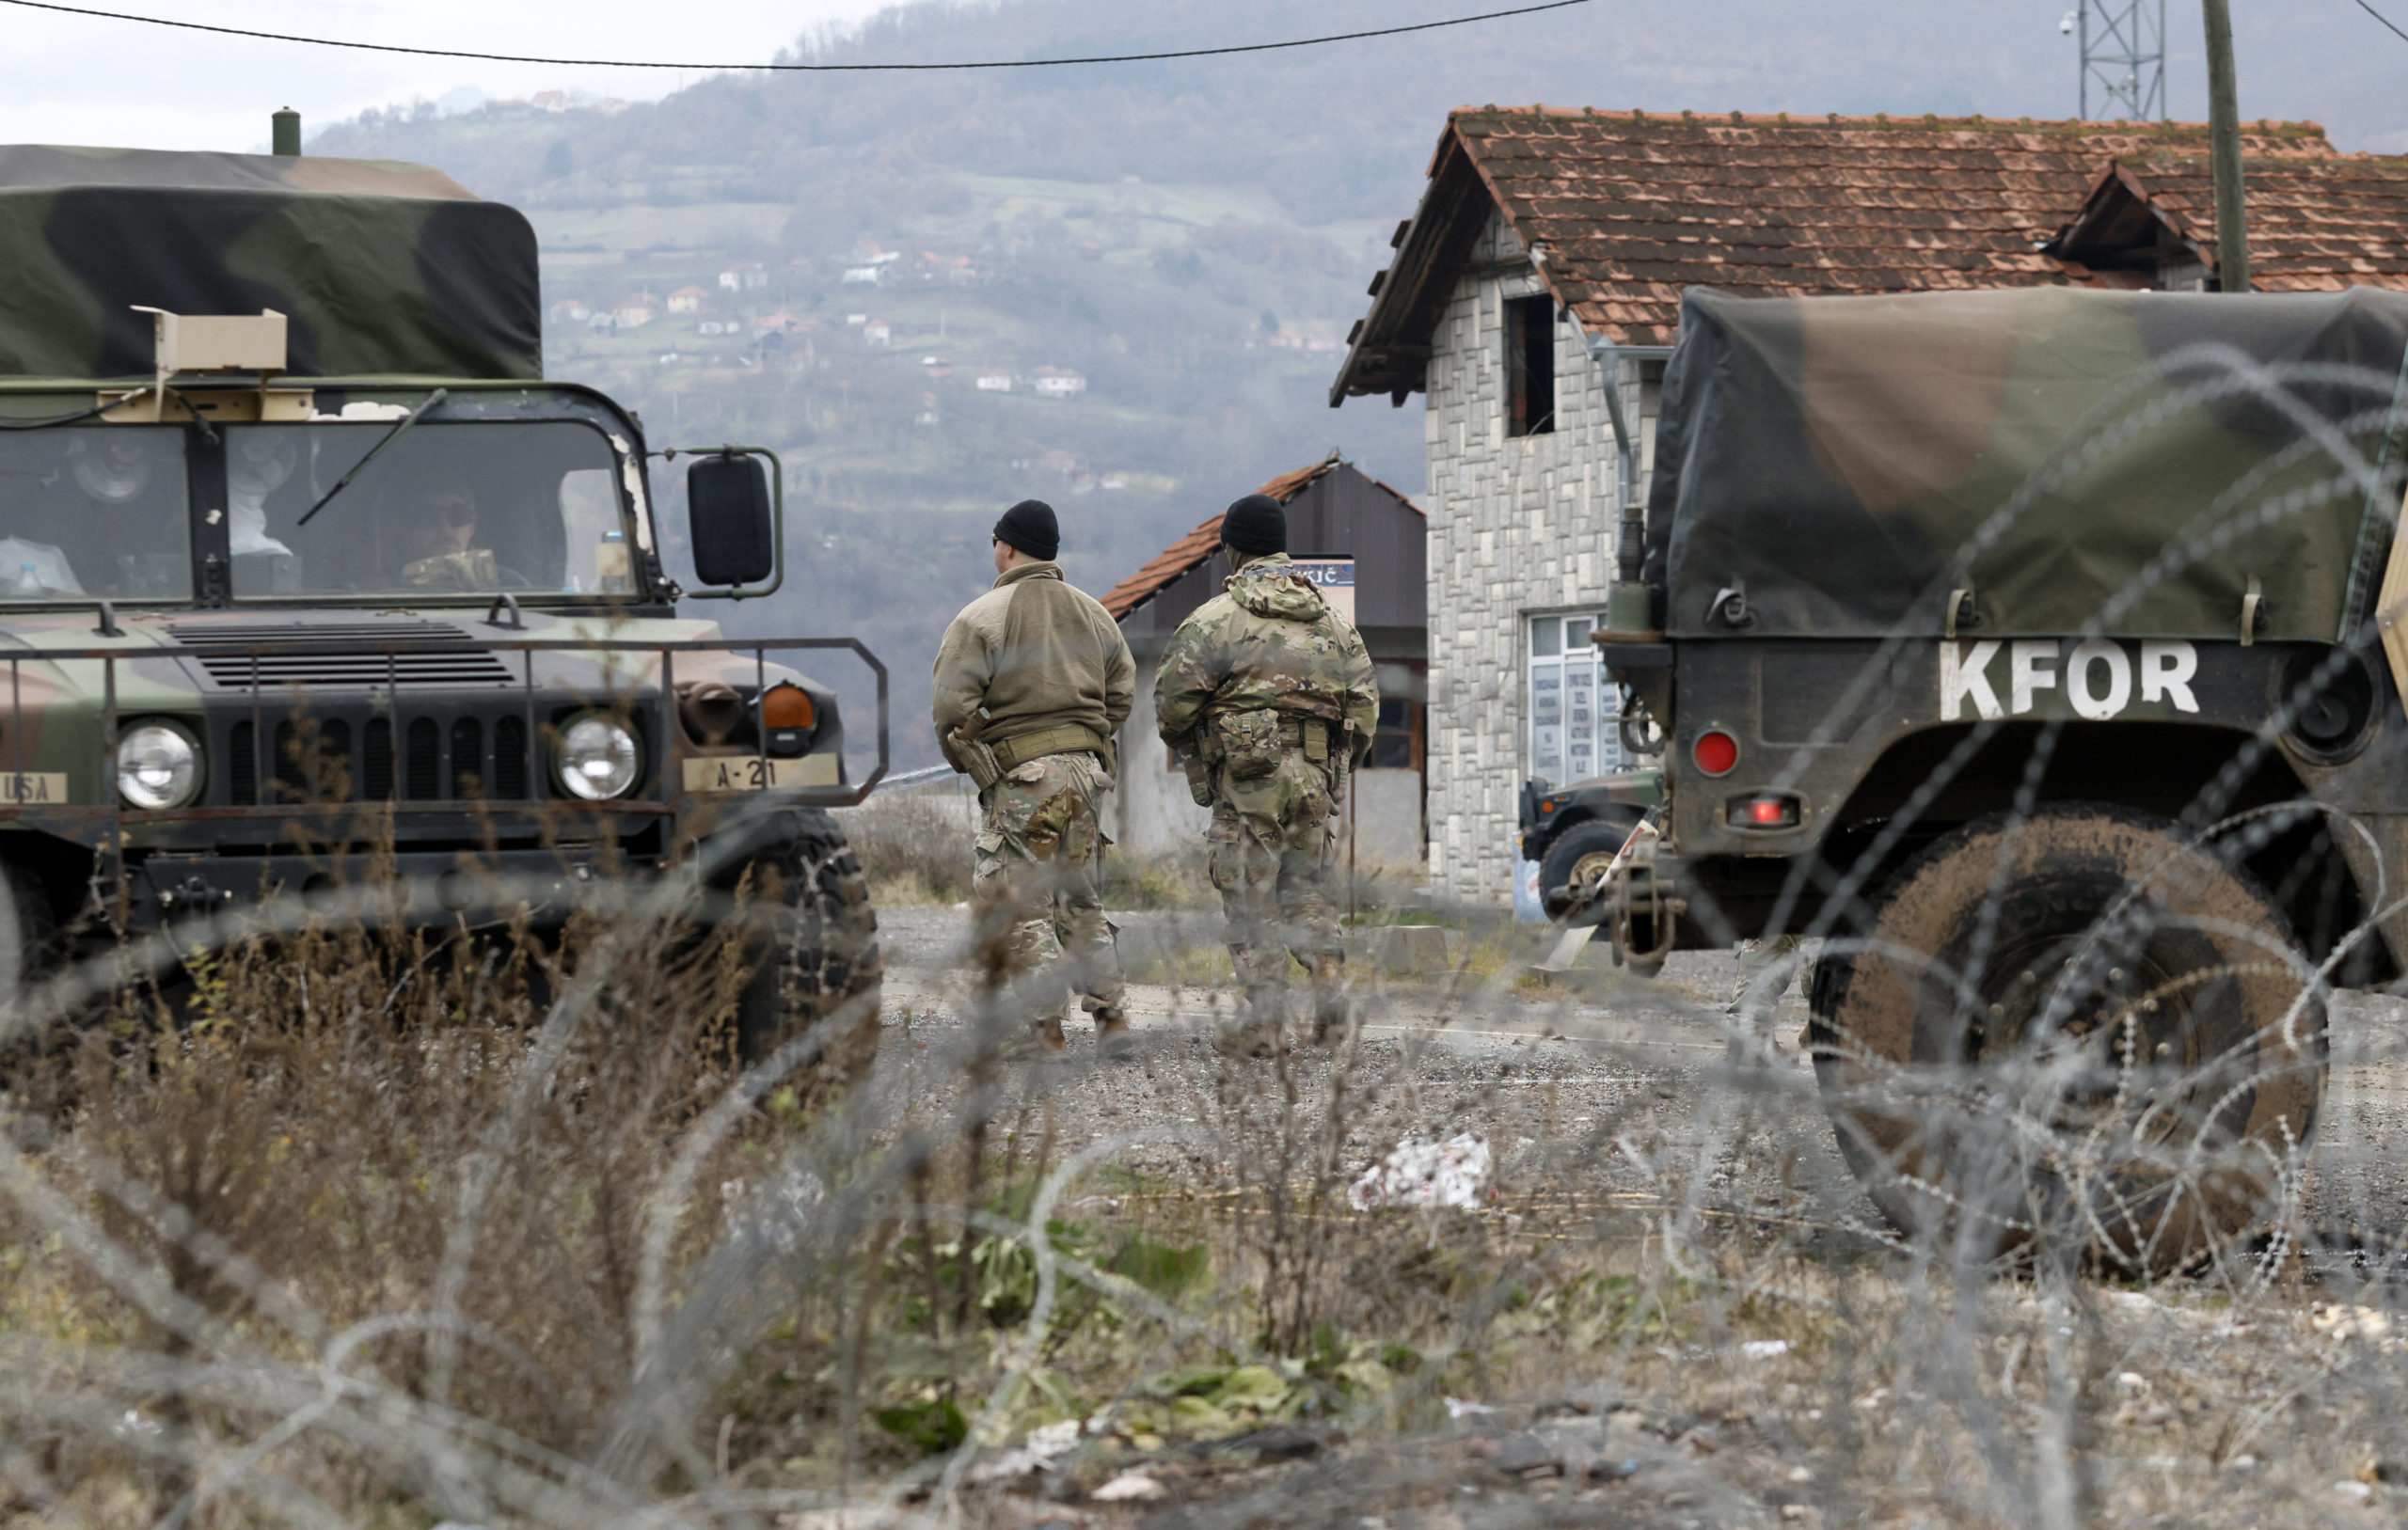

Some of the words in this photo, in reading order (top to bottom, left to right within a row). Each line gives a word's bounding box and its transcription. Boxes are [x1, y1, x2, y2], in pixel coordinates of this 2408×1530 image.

[1939, 639, 2199, 721] KFOR
[4, 775, 49, 800] USA
[717, 760, 776, 788] A-21
